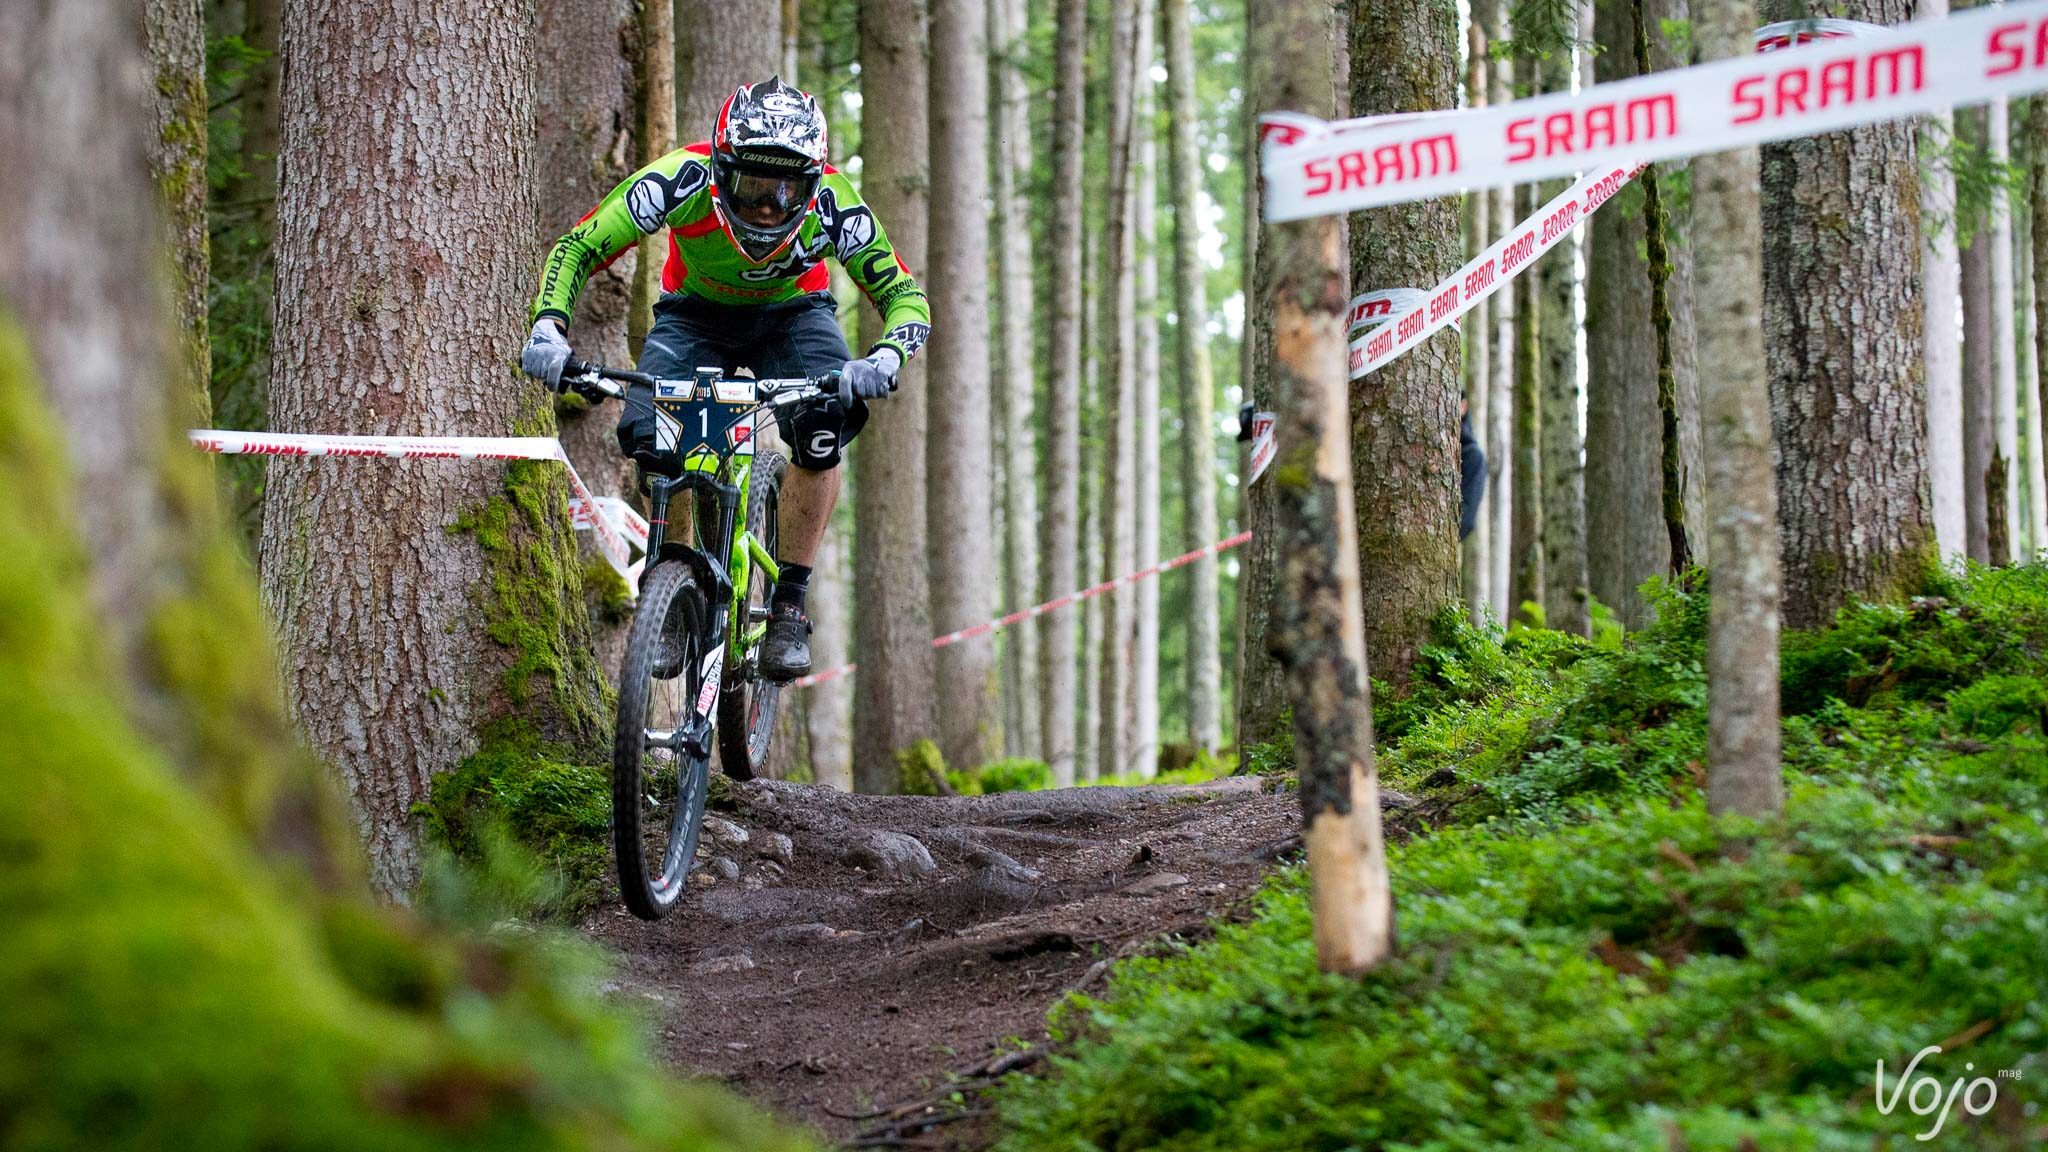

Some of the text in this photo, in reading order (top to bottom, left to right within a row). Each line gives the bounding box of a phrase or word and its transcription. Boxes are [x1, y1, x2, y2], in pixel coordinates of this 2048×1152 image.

[1303, 133, 1460, 197] SRAM
[1506, 92, 1677, 164] SRAM
[1732, 45, 1926, 125] SRAM
[741, 152, 803, 168] CANNONDALE
[1367, 329, 1393, 363] SRAM
[1397, 307, 1425, 345] SRAM
[1430, 284, 1459, 324] SRAM
[1464, 259, 1496, 300] SRAM
[1501, 230, 1536, 275] SRAM
[1540, 199, 1579, 246] SRAM
[696, 385, 711, 398] 2015
[698, 407, 708, 438] 1
